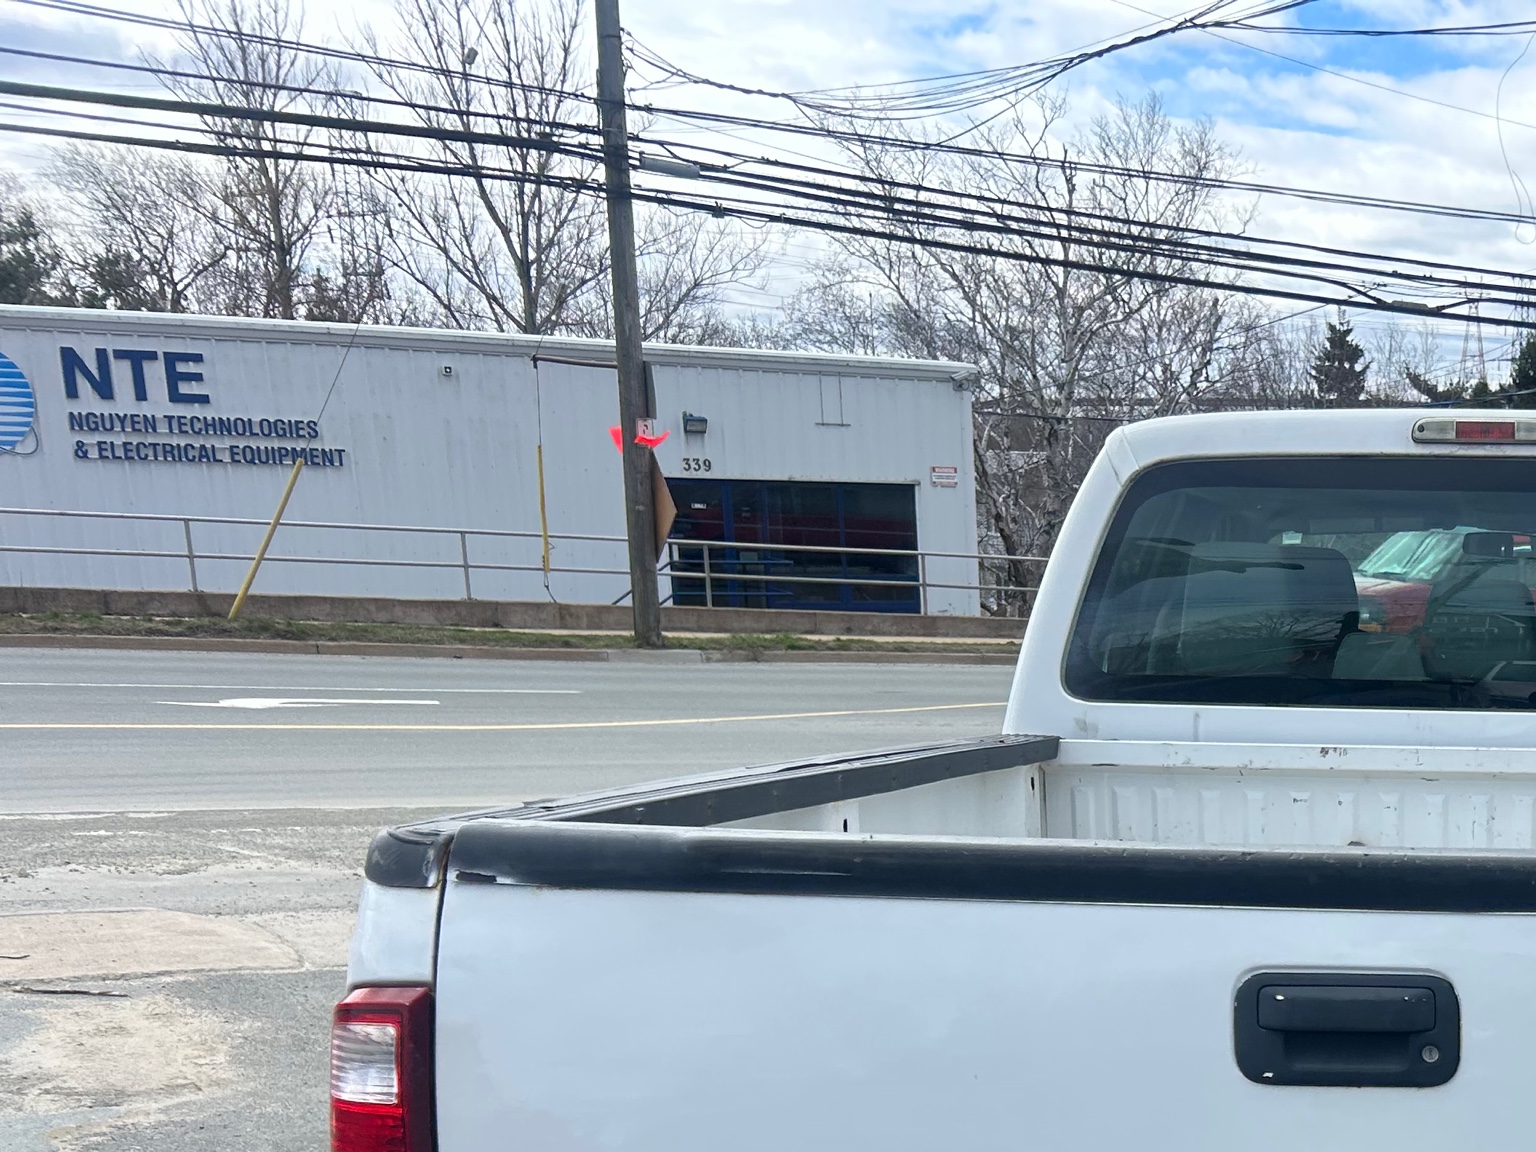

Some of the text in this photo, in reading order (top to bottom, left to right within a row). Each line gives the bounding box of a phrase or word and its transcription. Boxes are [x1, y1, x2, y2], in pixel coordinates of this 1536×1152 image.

[60, 346, 210, 404] NTE
[69, 411, 319, 438] NGUYEN TECHNOLOGIES
[74, 440, 346, 467] & ELECTRICAL EQUIPMENT
[683, 458, 711, 471] 339
